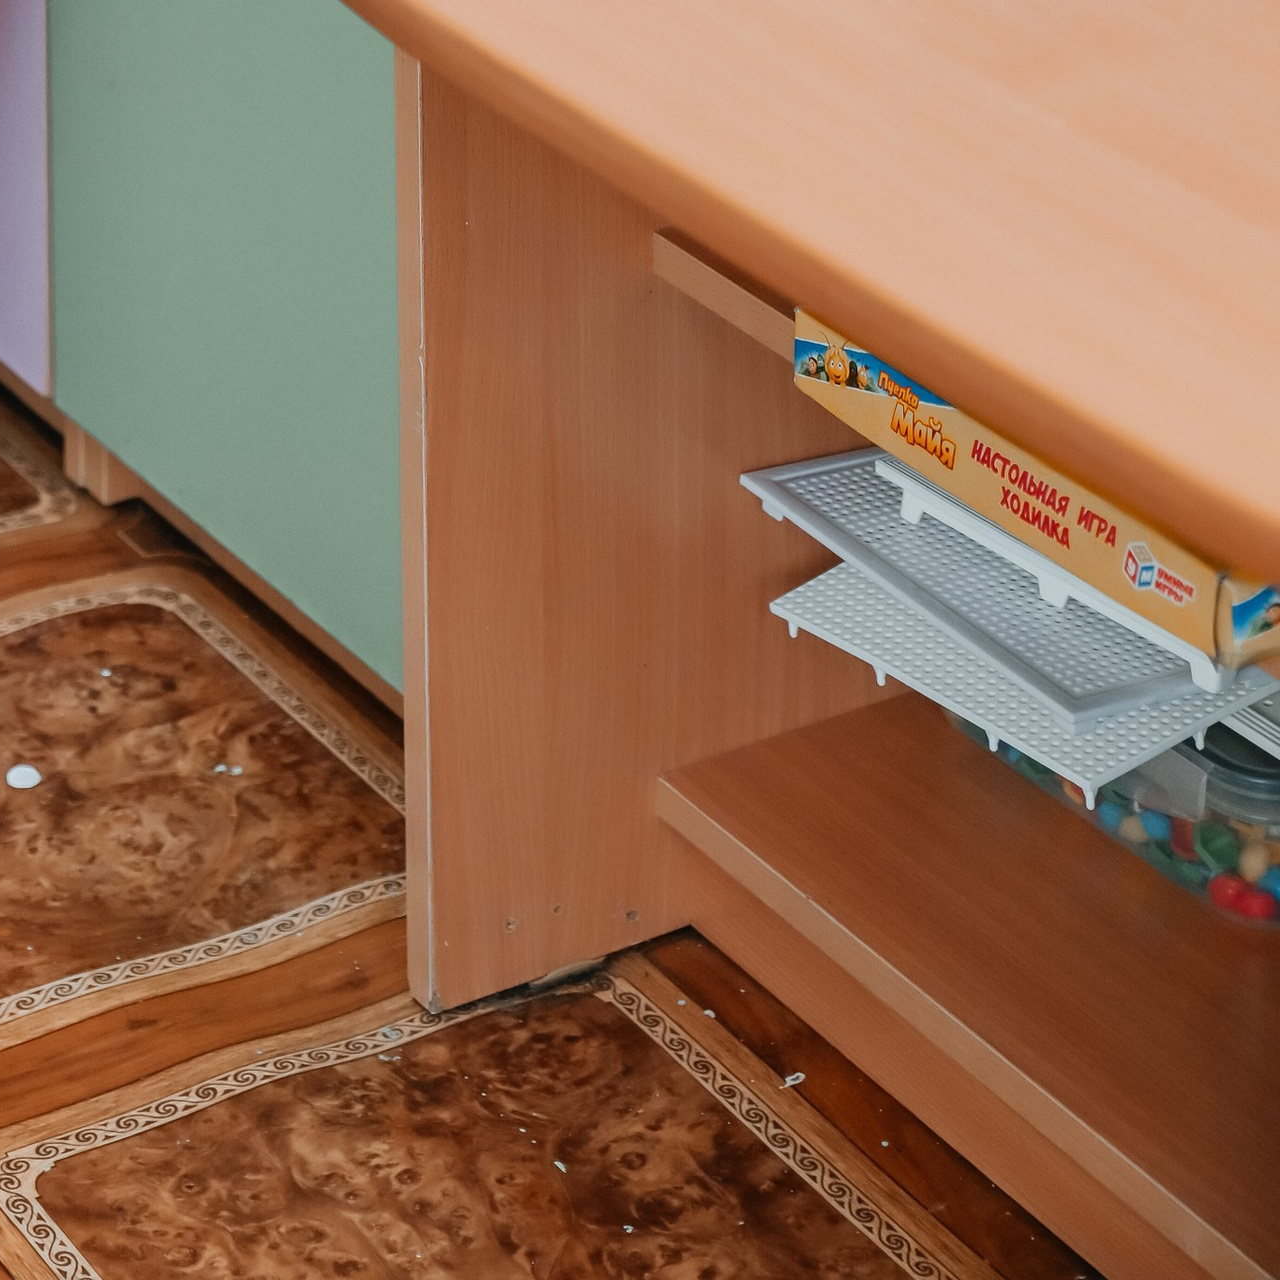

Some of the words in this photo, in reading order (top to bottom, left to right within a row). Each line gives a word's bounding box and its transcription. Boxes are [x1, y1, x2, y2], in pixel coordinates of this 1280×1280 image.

[877, 370, 920, 410] Пчелка
[890, 400, 958, 471] Майя
[971, 439, 1071, 518] НАСТОЛЬНАЯ
[1077, 505, 1118, 549] ИГРА
[1000, 485, 1071, 551] ХОДИЛКА
[1154, 579, 1185, 604] ИГРЫ
[1156, 567, 1195, 599] УМНЫЕ
